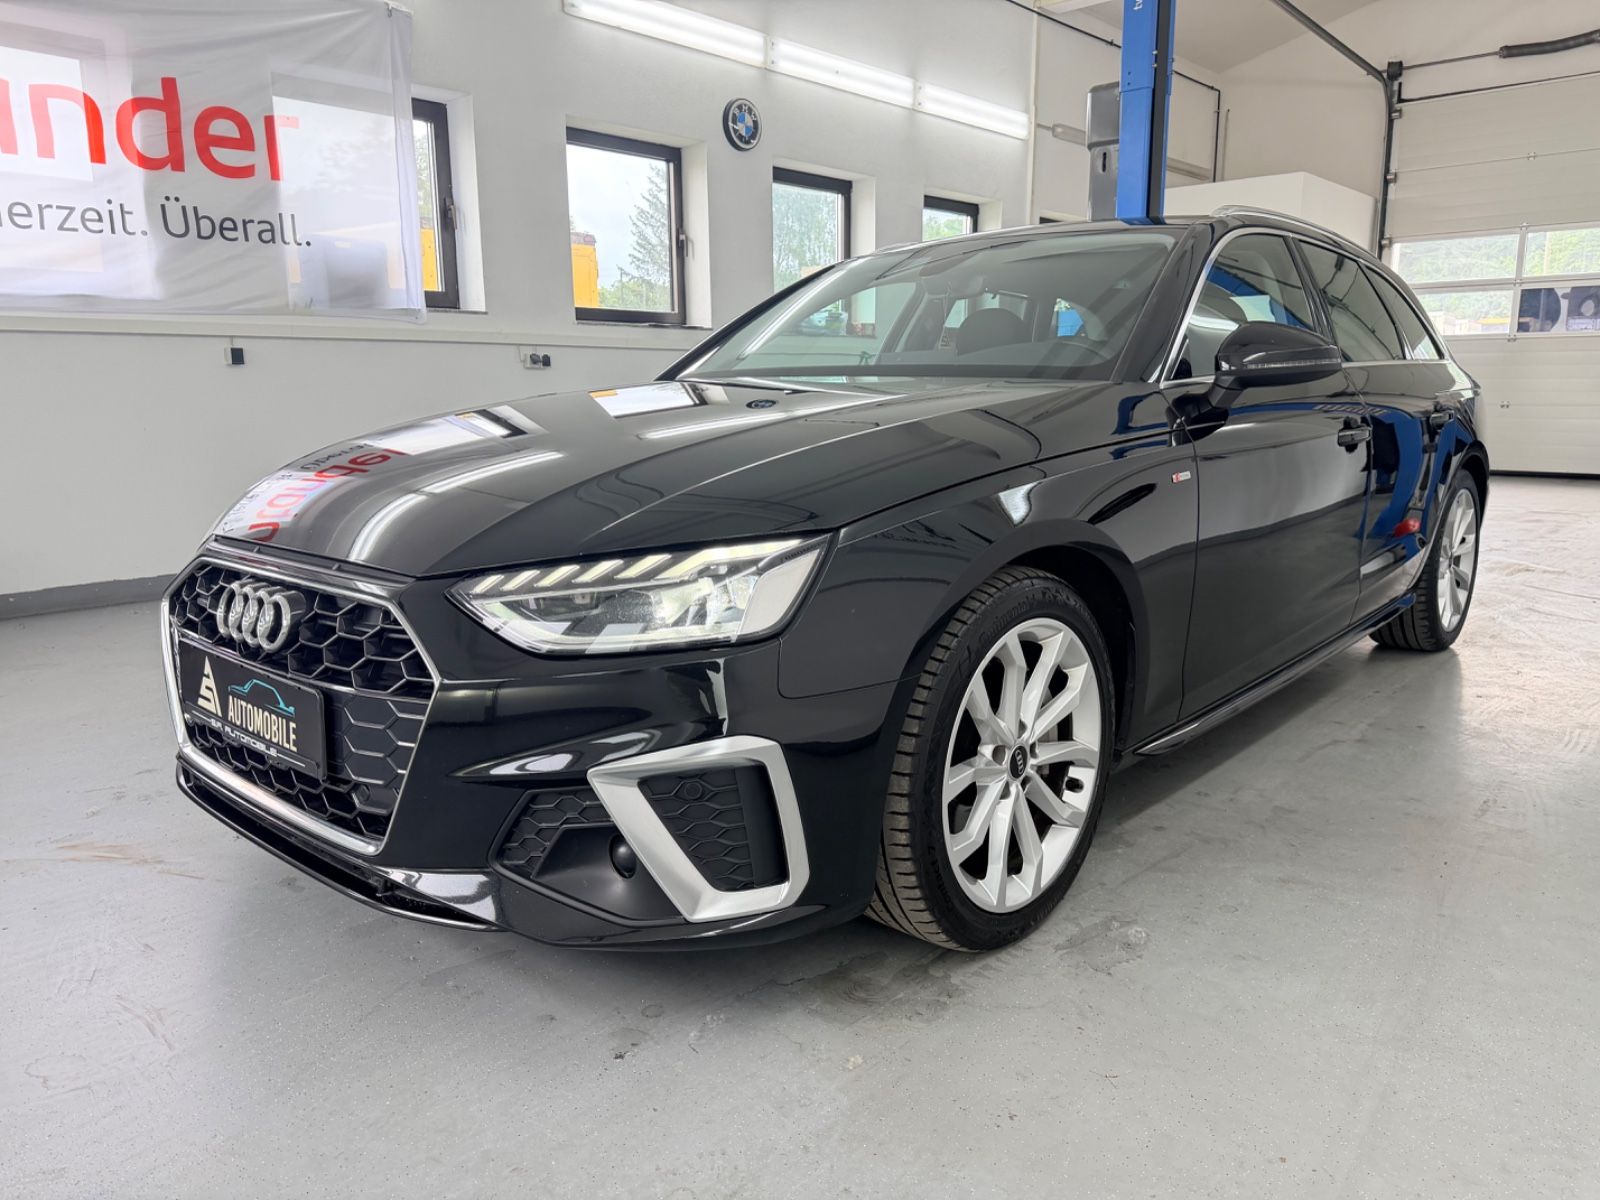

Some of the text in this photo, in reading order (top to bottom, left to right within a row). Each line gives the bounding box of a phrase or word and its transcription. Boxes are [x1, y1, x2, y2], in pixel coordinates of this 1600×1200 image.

[0, 195, 312, 248] erzeit. Überall.
[228, 695, 298, 752] AUTOMOBILE
